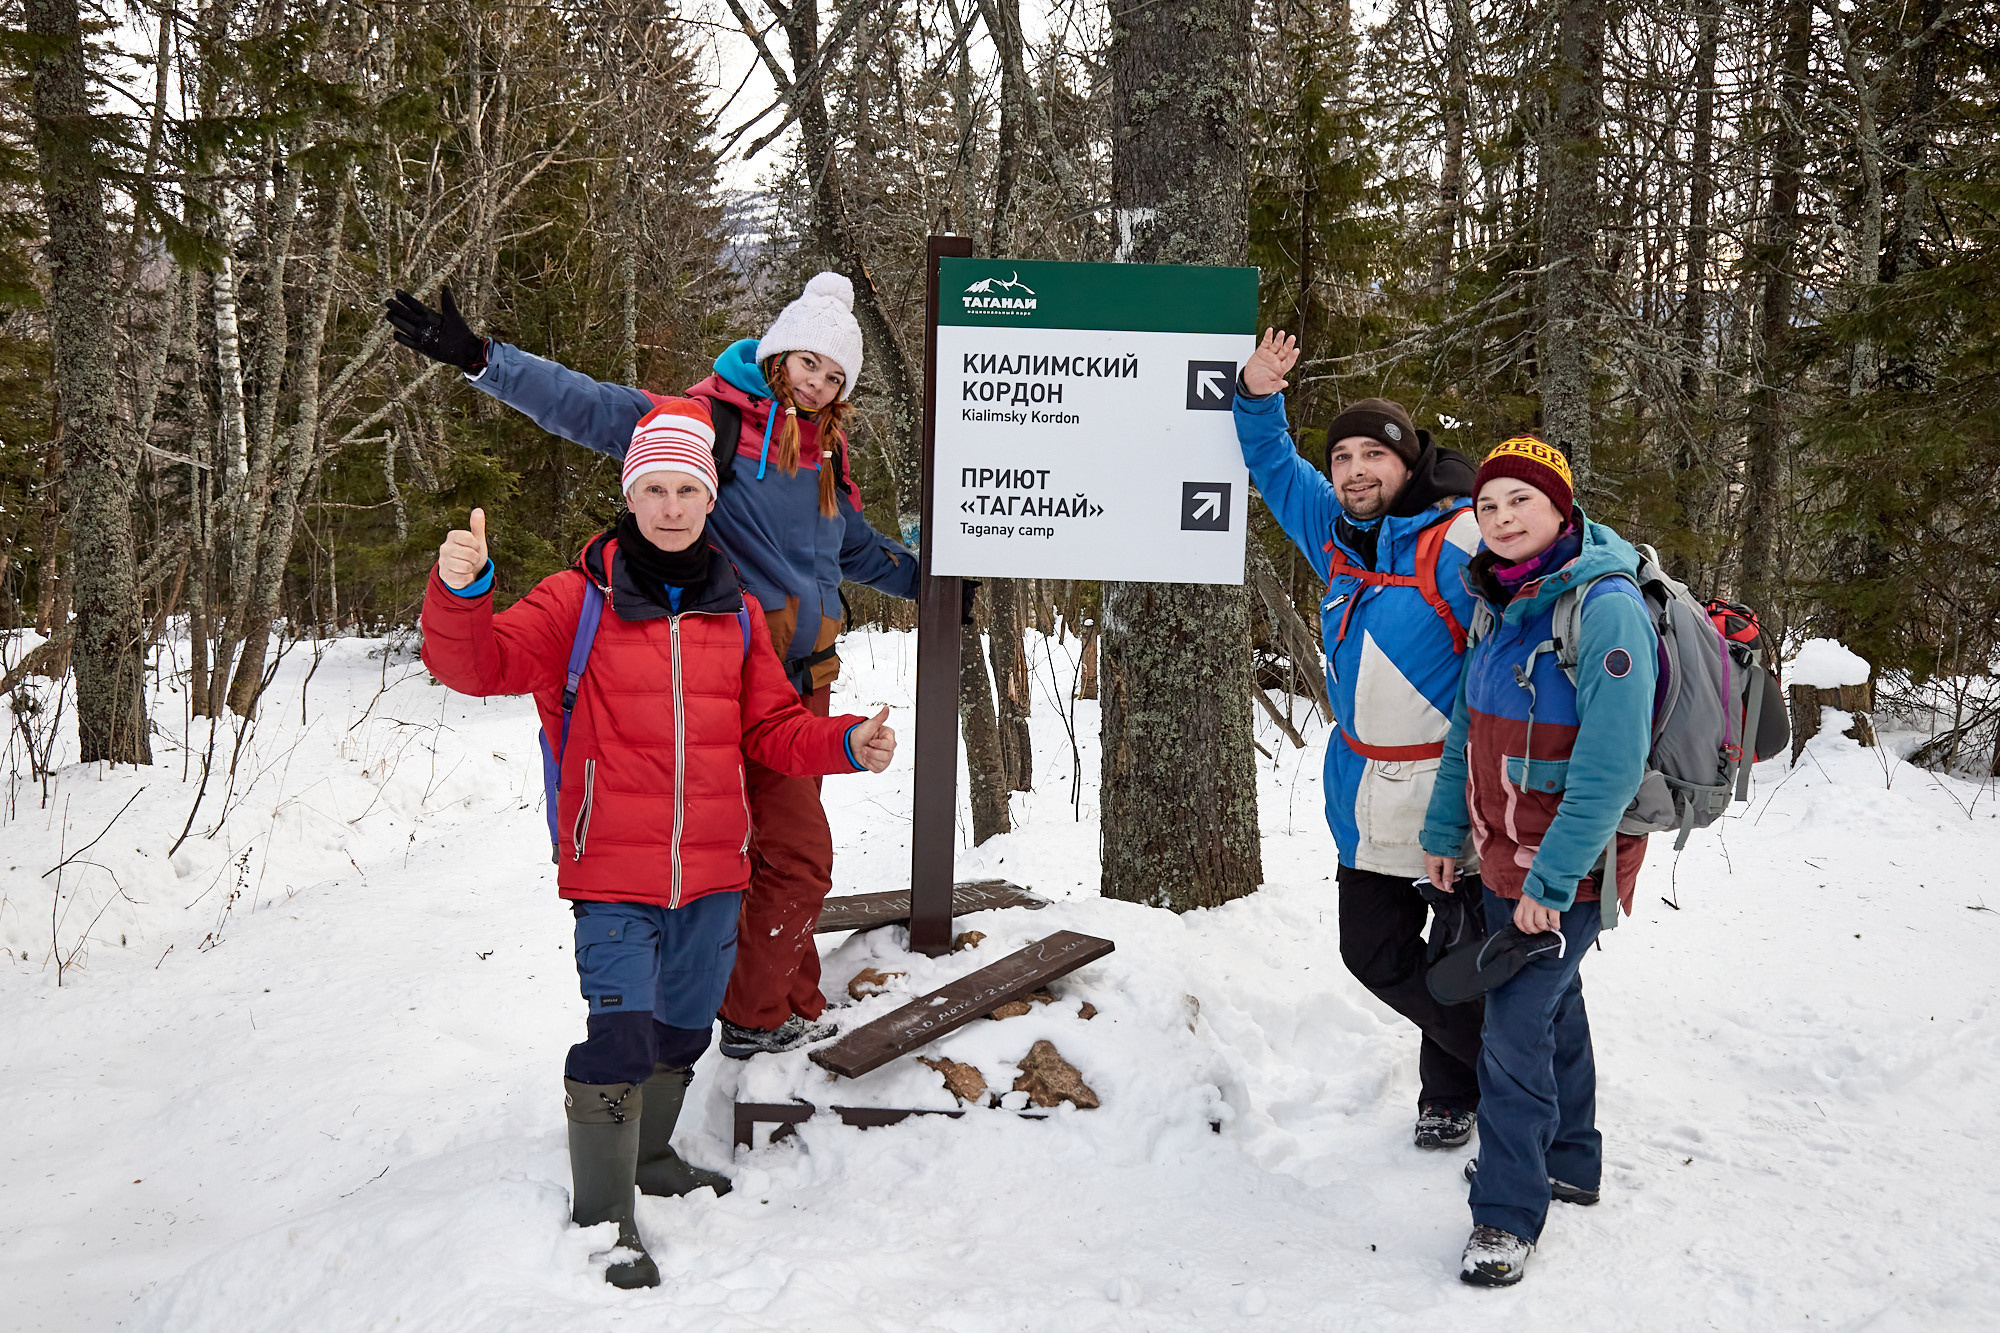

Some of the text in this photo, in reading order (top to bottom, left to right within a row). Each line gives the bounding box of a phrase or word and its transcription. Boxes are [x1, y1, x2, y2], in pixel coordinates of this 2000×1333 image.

[963, 352, 1138, 379] КИАЛИМСКИЙ
[962, 380, 1063, 407] КОРДОН
[962, 408, 1080, 426] Kialimsky Kordon
[961, 467, 1051, 490] ПРИЮТ
[960, 492, 1105, 518] «ТАГАНАЙ»
[960, 521, 1055, 540] Taganay camp
